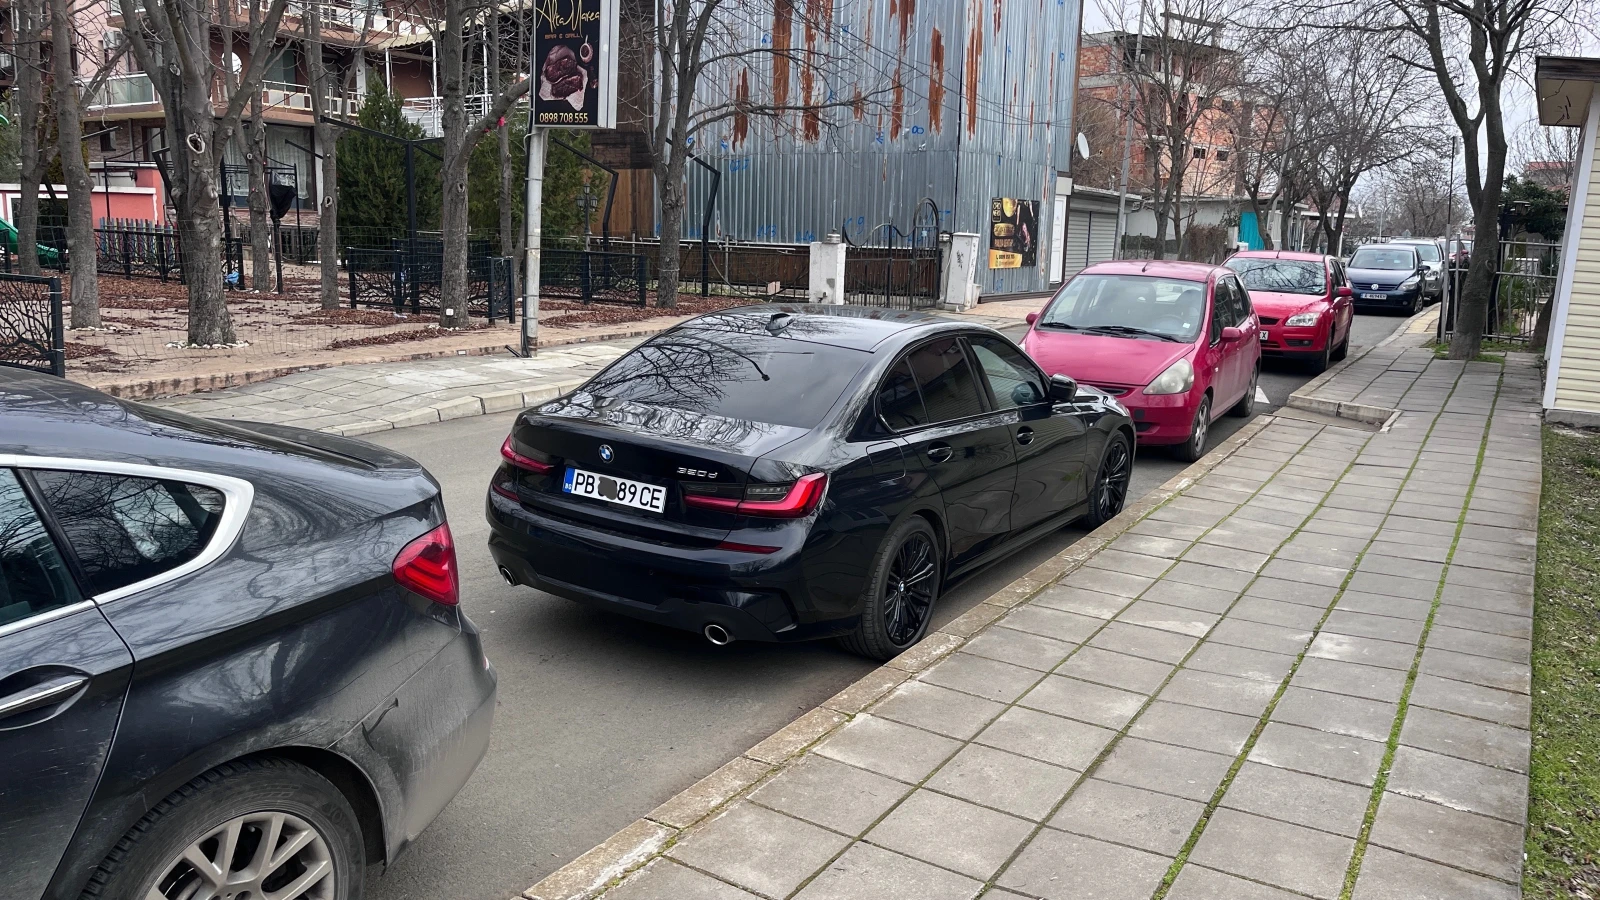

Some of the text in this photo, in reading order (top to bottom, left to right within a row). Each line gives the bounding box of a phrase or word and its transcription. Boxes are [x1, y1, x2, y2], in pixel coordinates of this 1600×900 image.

[539, 112, 589, 123] 0898 708 555
[574, 473, 662, 509] PB 89 CE
